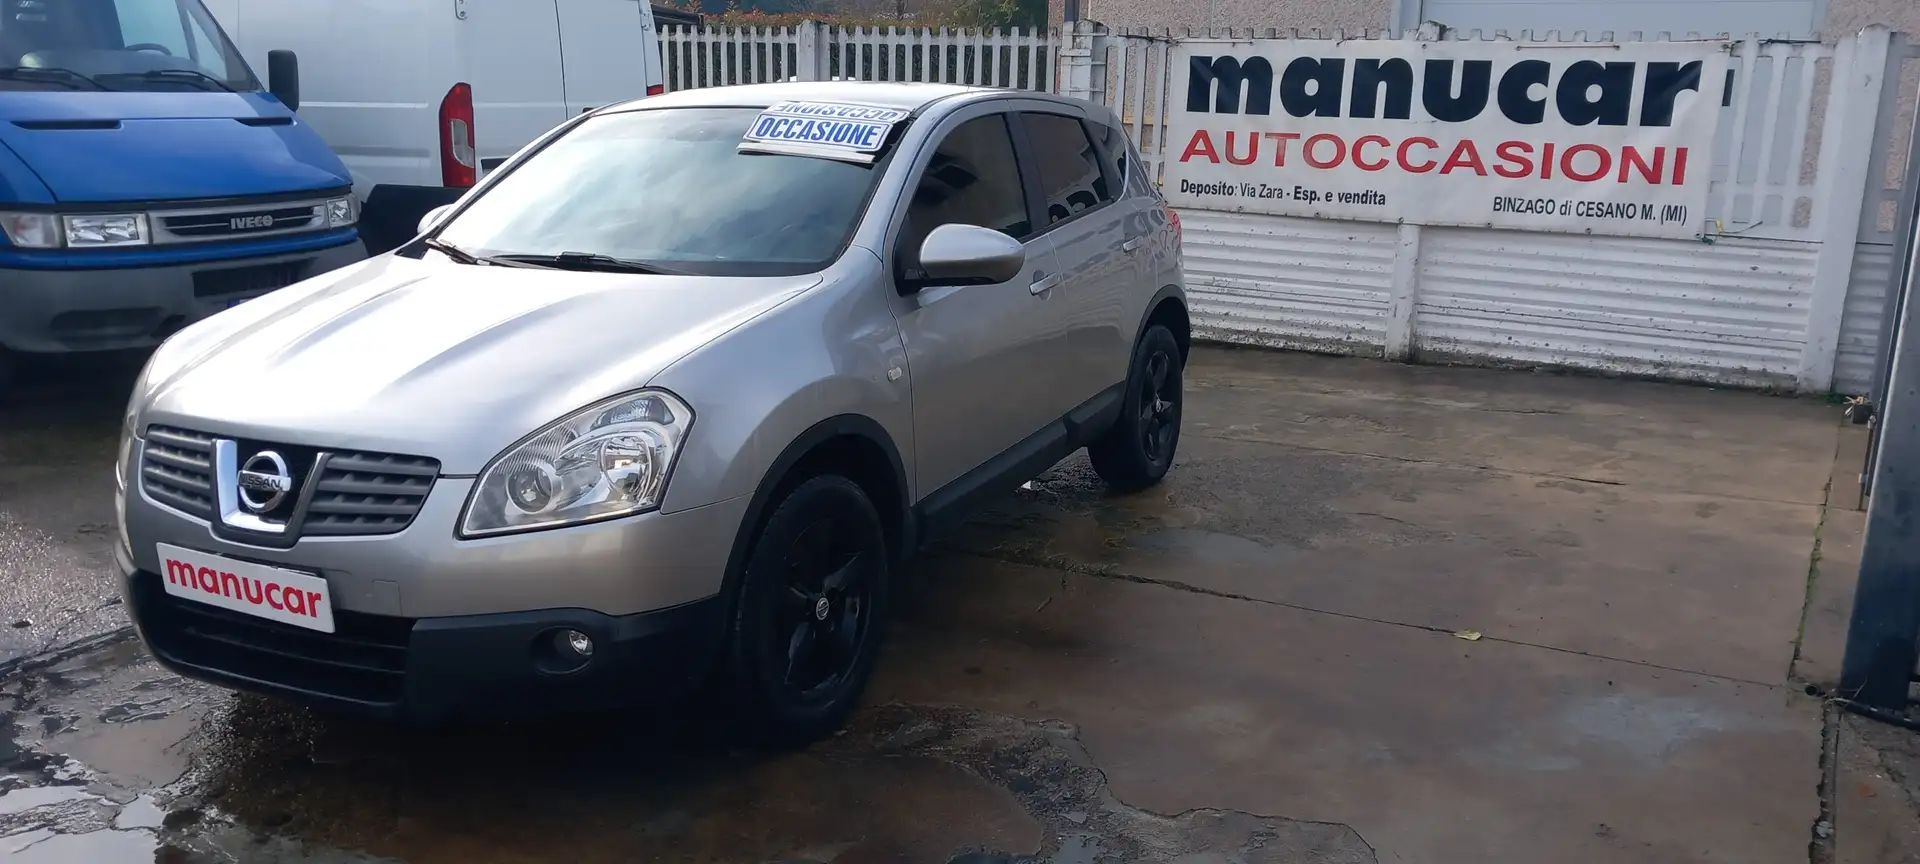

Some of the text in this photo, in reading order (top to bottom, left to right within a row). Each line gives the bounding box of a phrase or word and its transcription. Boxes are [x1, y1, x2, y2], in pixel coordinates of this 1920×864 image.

[1186, 54, 1703, 126] manucar
[755, 117, 881, 146] OCCASIONE
[1179, 129, 1688, 185] AUTOCCASIONI
[1180, 179, 1238, 197] Deposito:
[1240, 182, 1256, 197] Via
[1259, 184, 1283, 199] Zara
[1293, 185, 1320, 204] Esp.
[1325, 191, 1333, 202] e
[1337, 189, 1386, 206] vendita
[230, 214, 273, 229] IVECO
[1493, 196, 1688, 226] BINZAGO di CESANO M. (MI)
[166, 557, 322, 618] manucar
